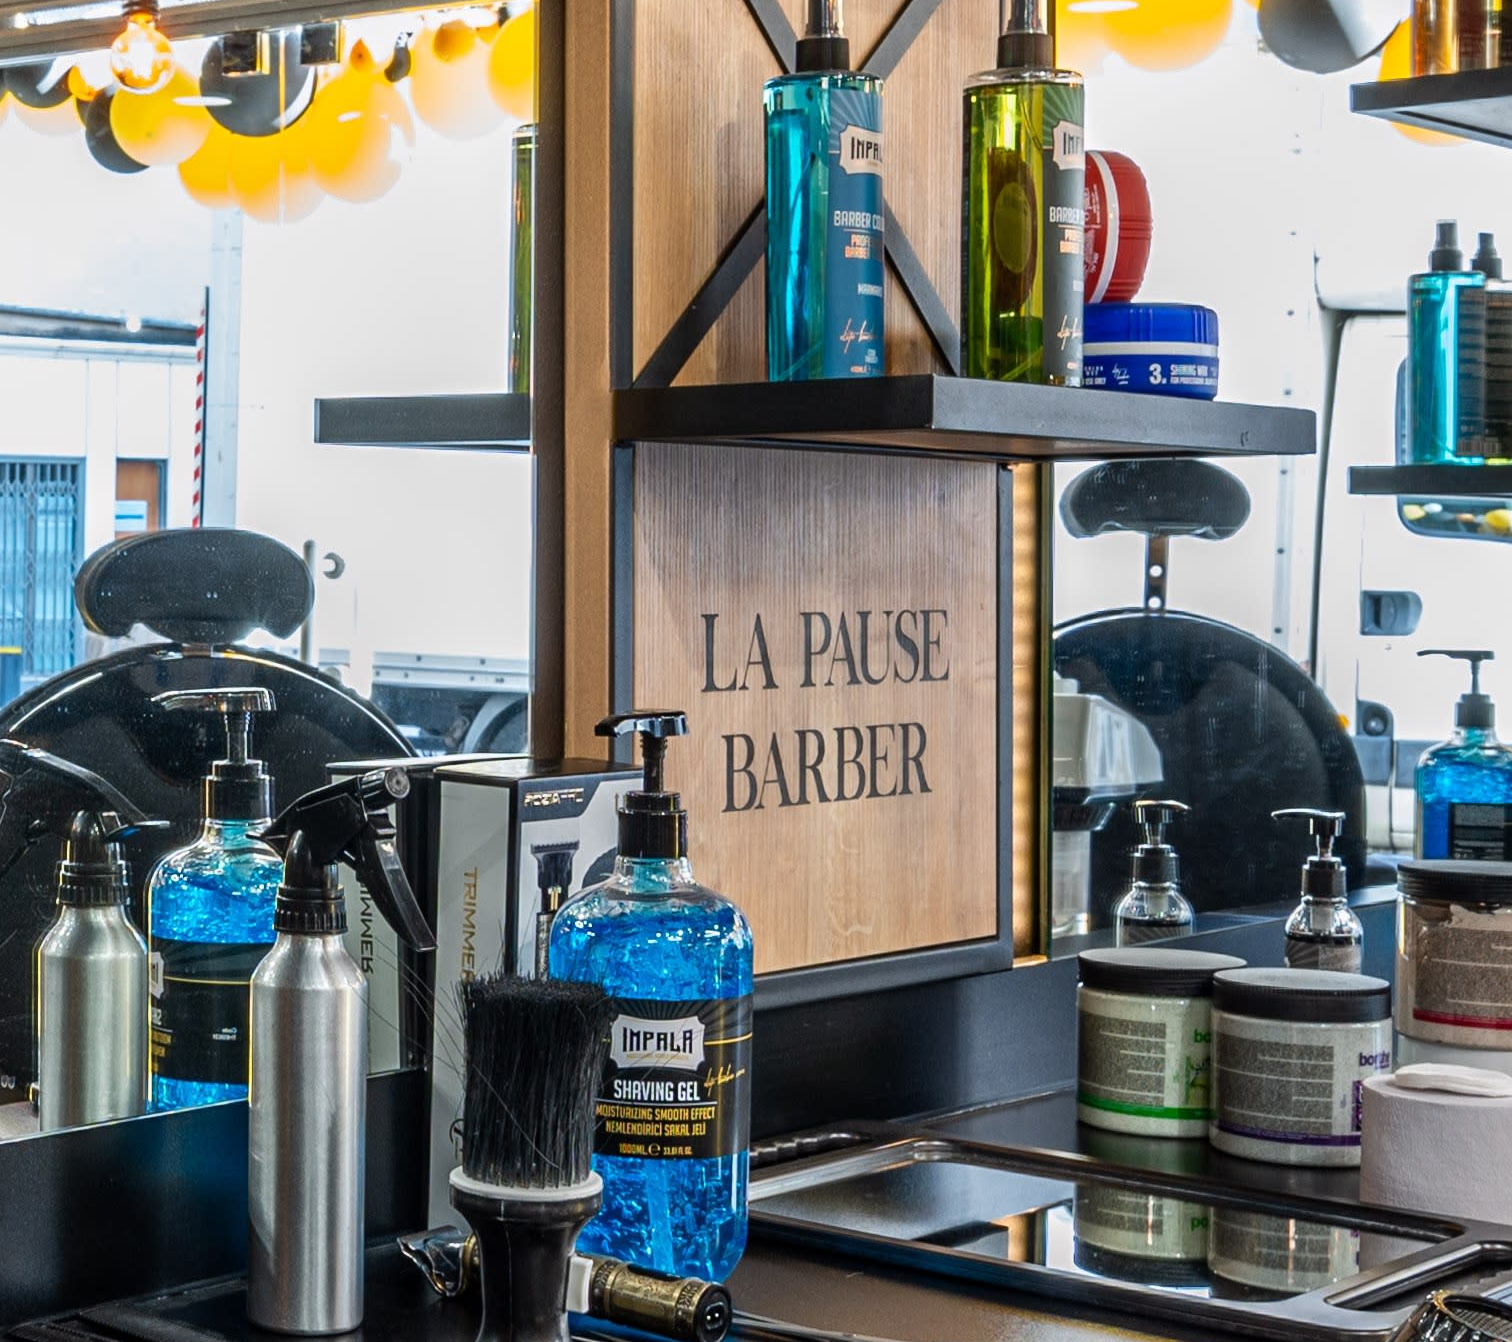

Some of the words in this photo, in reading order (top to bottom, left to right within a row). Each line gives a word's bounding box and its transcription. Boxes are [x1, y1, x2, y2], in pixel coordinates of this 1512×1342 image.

[833, 210, 872, 229] BARBER
[700, 612, 780, 694] LA
[799, 609, 951, 689] PAUSE
[721, 721, 933, 813] BARBER
[622, 1027, 693, 1054] IMPALA
[613, 1079, 674, 1102] SHAVING
[677, 1082, 700, 1102] GEL
[595, 1106, 653, 1120] MOISTURIZING
[655, 1108, 689, 1120] SMOOTH
[690, 1107, 716, 1120] EFFECT
[664, 1123, 691, 1137] SAKAL
